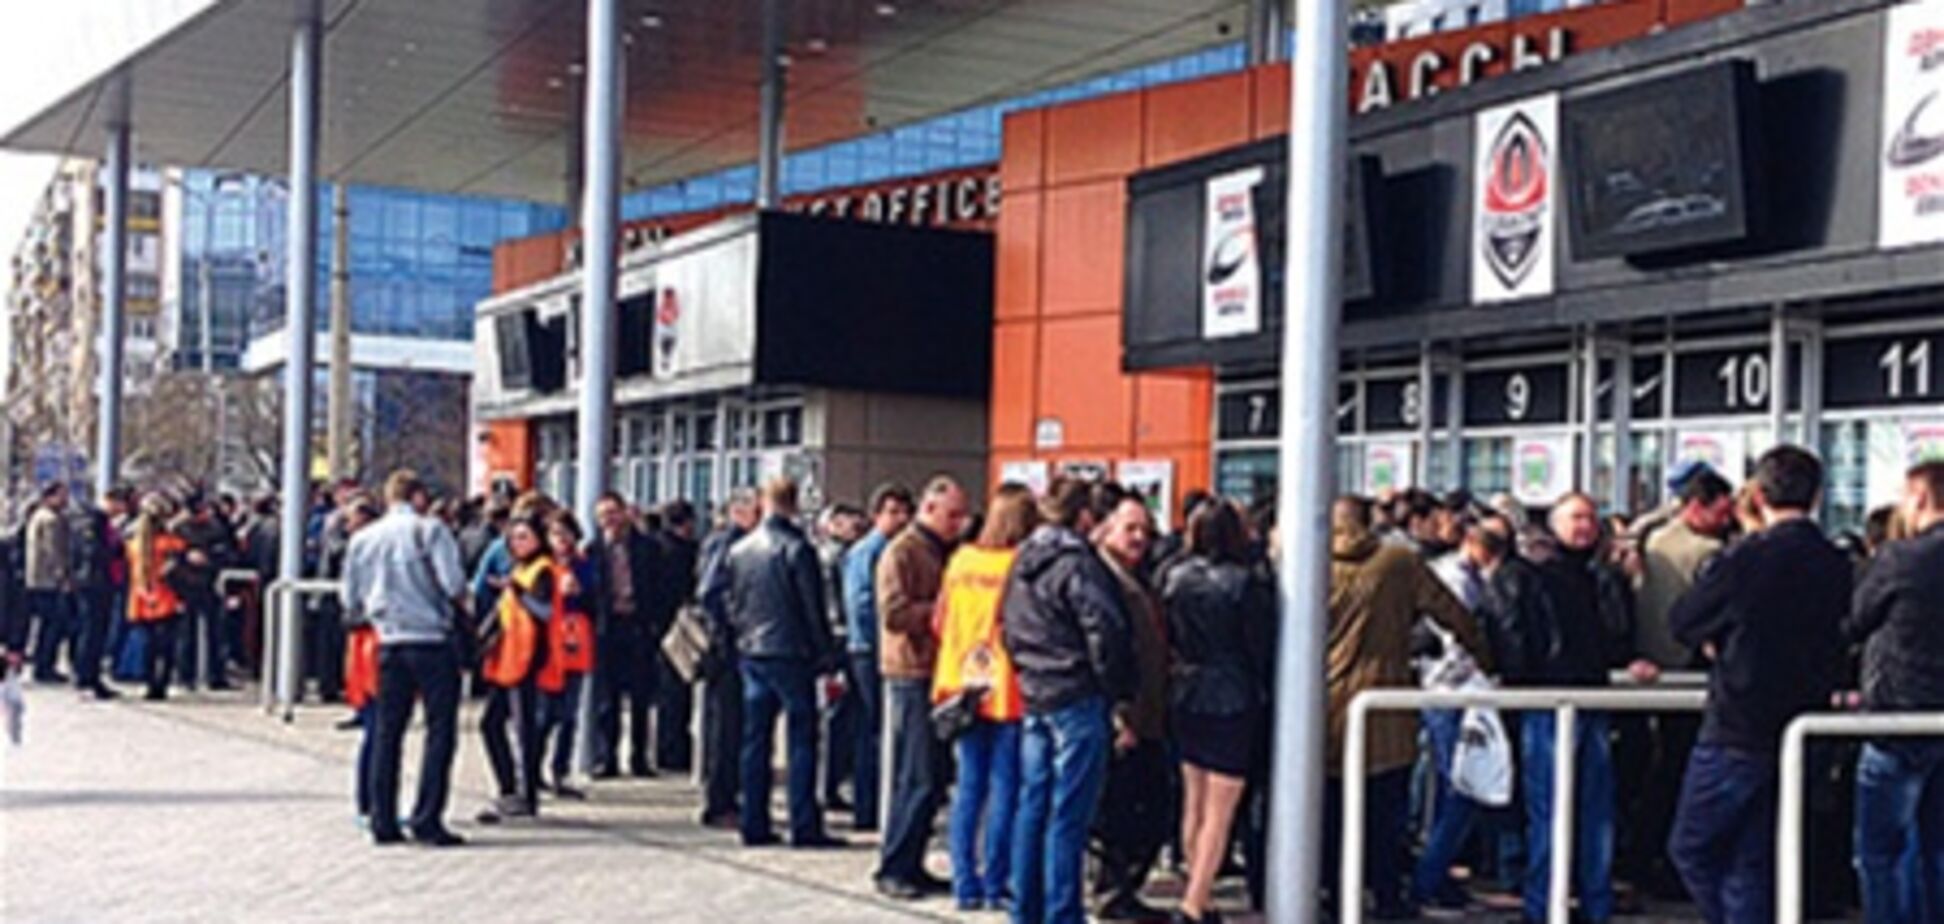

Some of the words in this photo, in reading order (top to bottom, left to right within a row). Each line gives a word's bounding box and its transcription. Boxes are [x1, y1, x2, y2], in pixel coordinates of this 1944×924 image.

[1358, 28, 1563, 113] АССЫ
[863, 175, 1000, 226] OFFICE
[1718, 353, 1768, 407] 10
[1880, 340, 1929, 398] 11
[1250, 395, 1265, 433] 7
[1402, 383, 1421, 425] 8
[1506, 373, 1530, 420] 9
